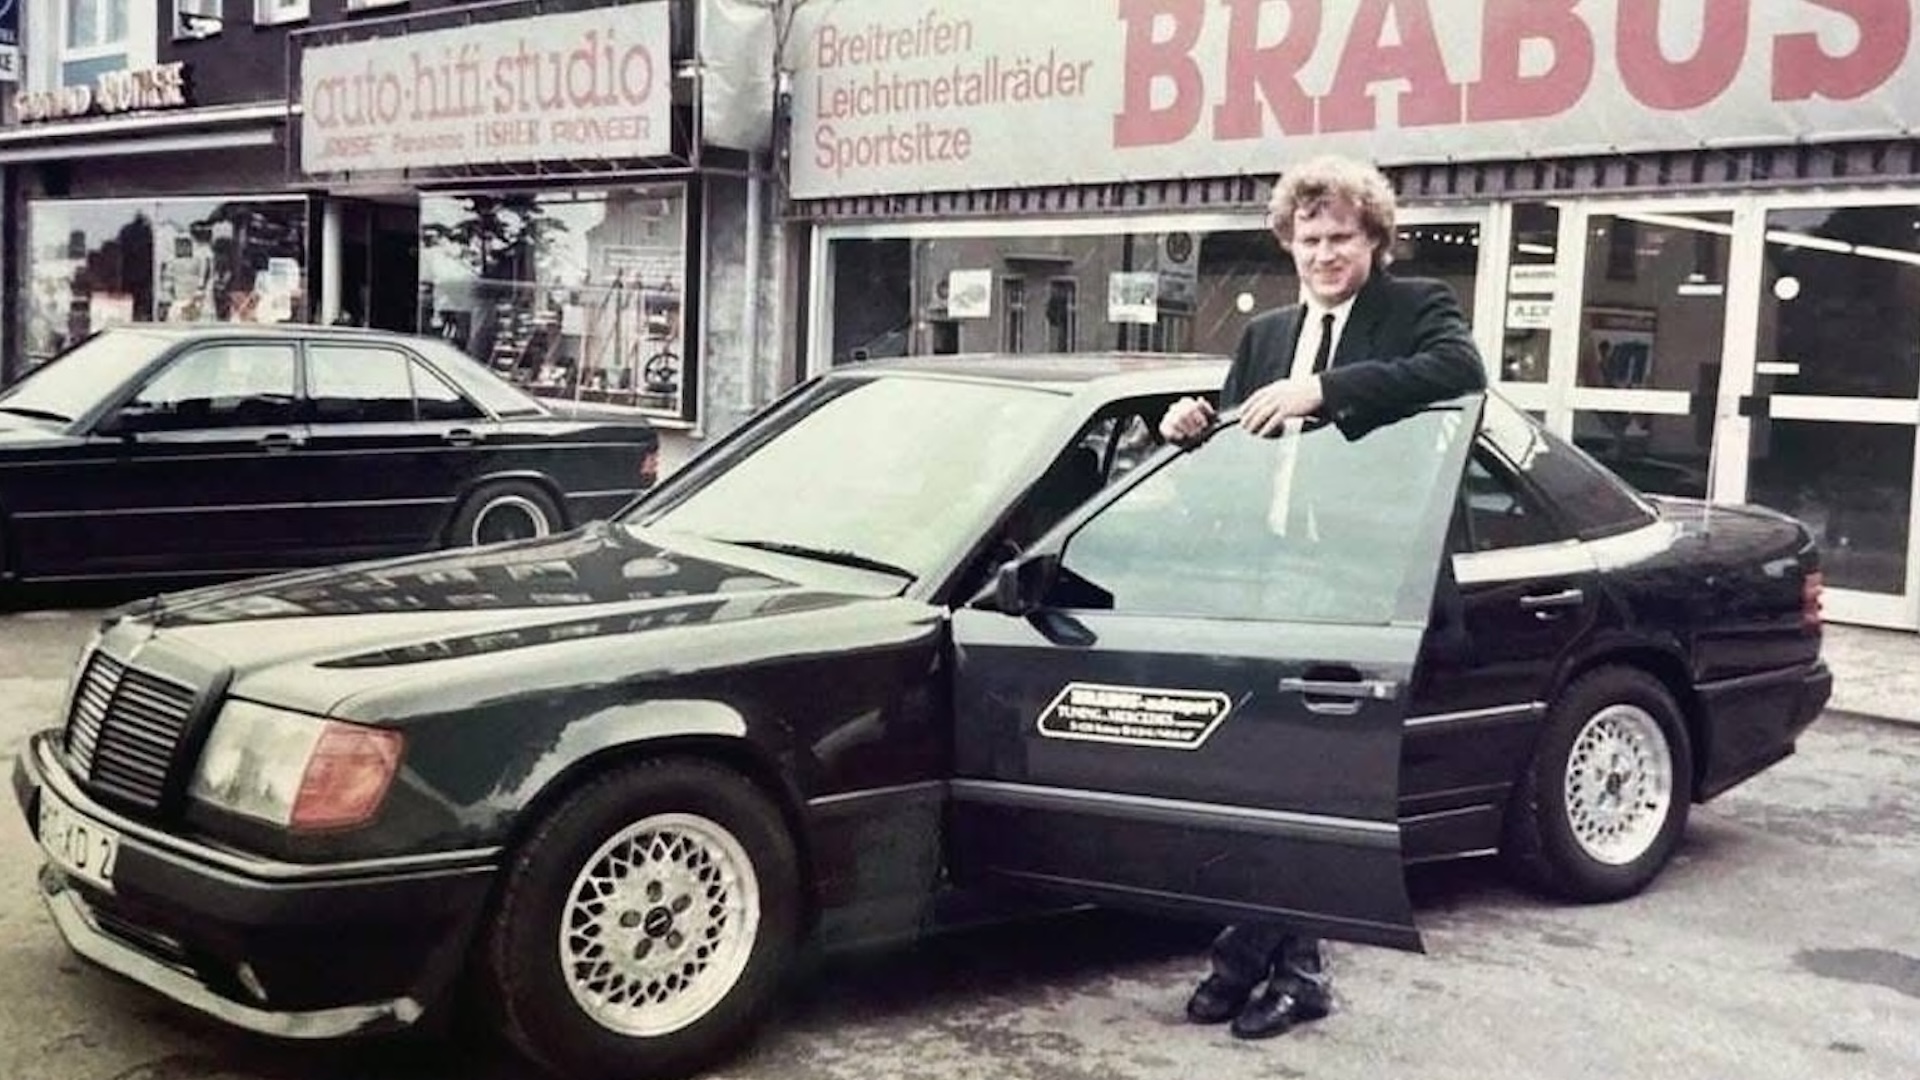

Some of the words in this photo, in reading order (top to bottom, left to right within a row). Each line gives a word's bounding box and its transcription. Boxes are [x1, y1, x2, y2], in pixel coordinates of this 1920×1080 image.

[817, 9, 973, 69] Breitreifen
[815, 46, 1094, 120] Leichtmetallräder
[1113, 0, 1911, 148] BRABUS
[815, 122, 973, 178] Sportsitze
